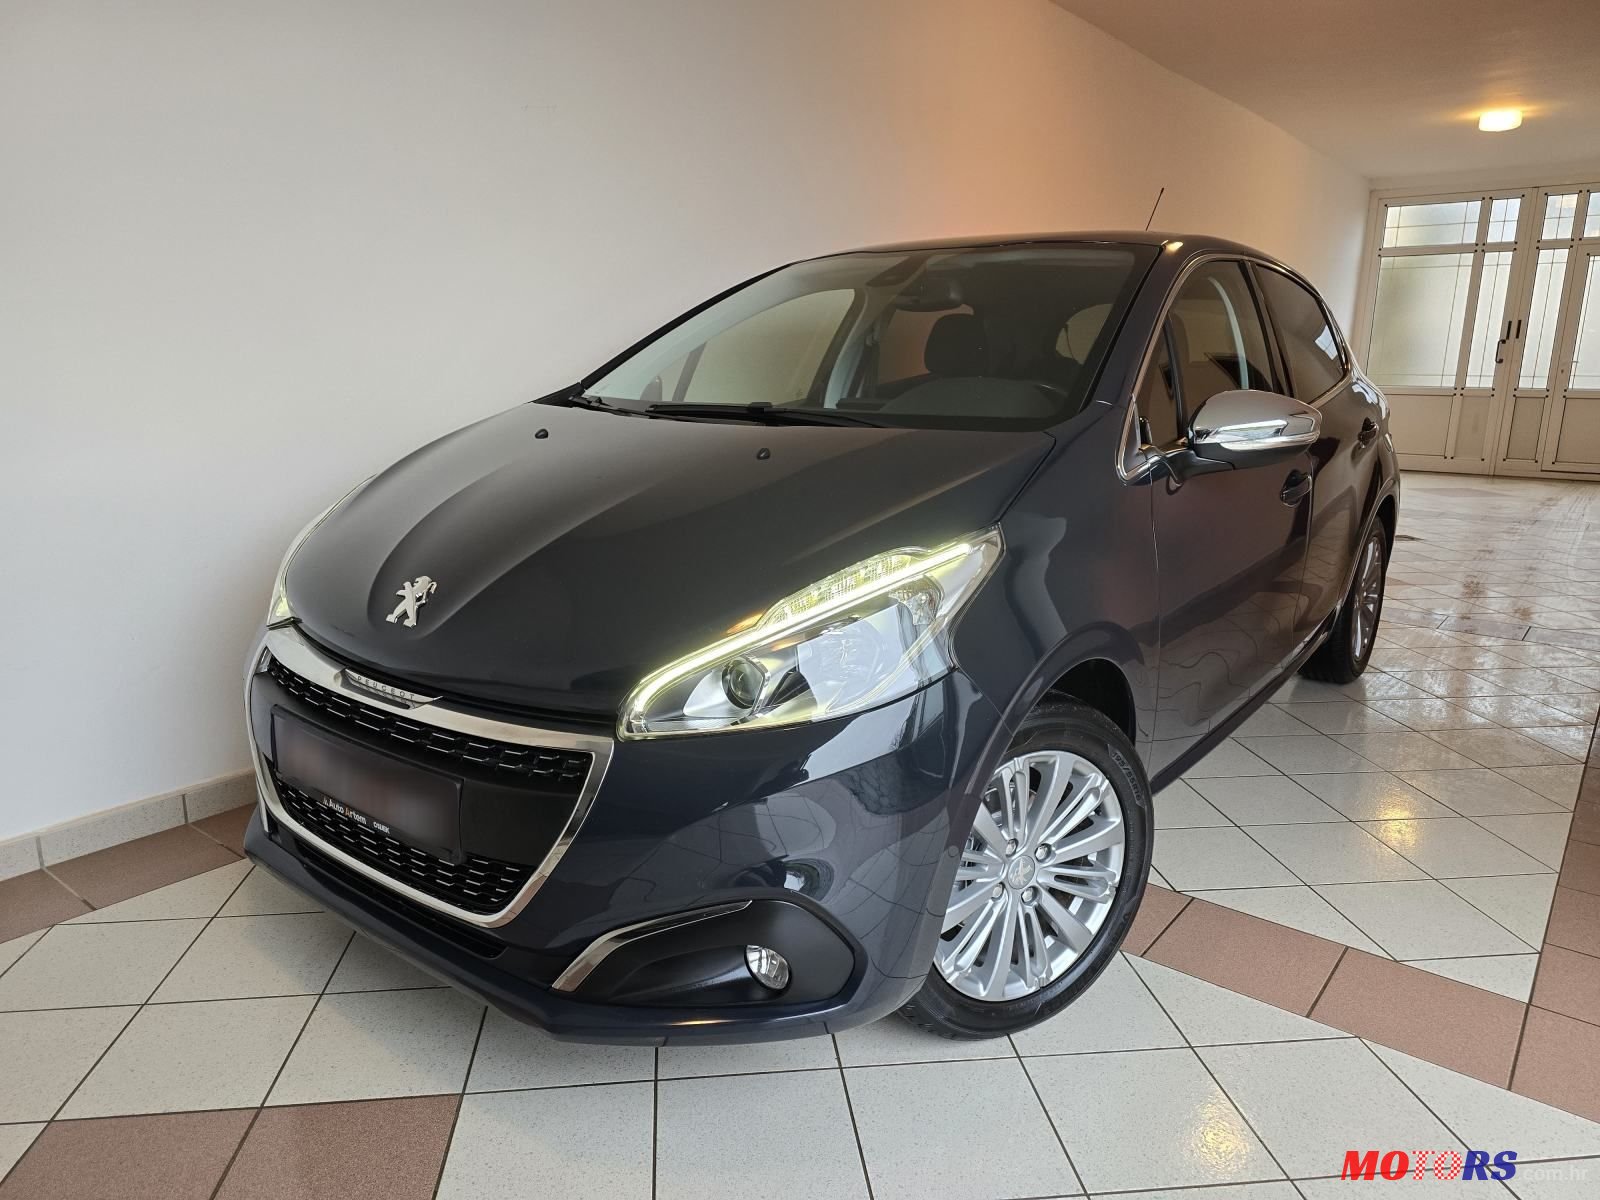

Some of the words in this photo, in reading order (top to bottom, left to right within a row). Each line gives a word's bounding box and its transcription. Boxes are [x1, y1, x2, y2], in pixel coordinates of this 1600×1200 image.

[357, 675, 415, 700] PEUGEOT
[328, 798, 345, 814] Auto
[344, 807, 367, 825] Artem
